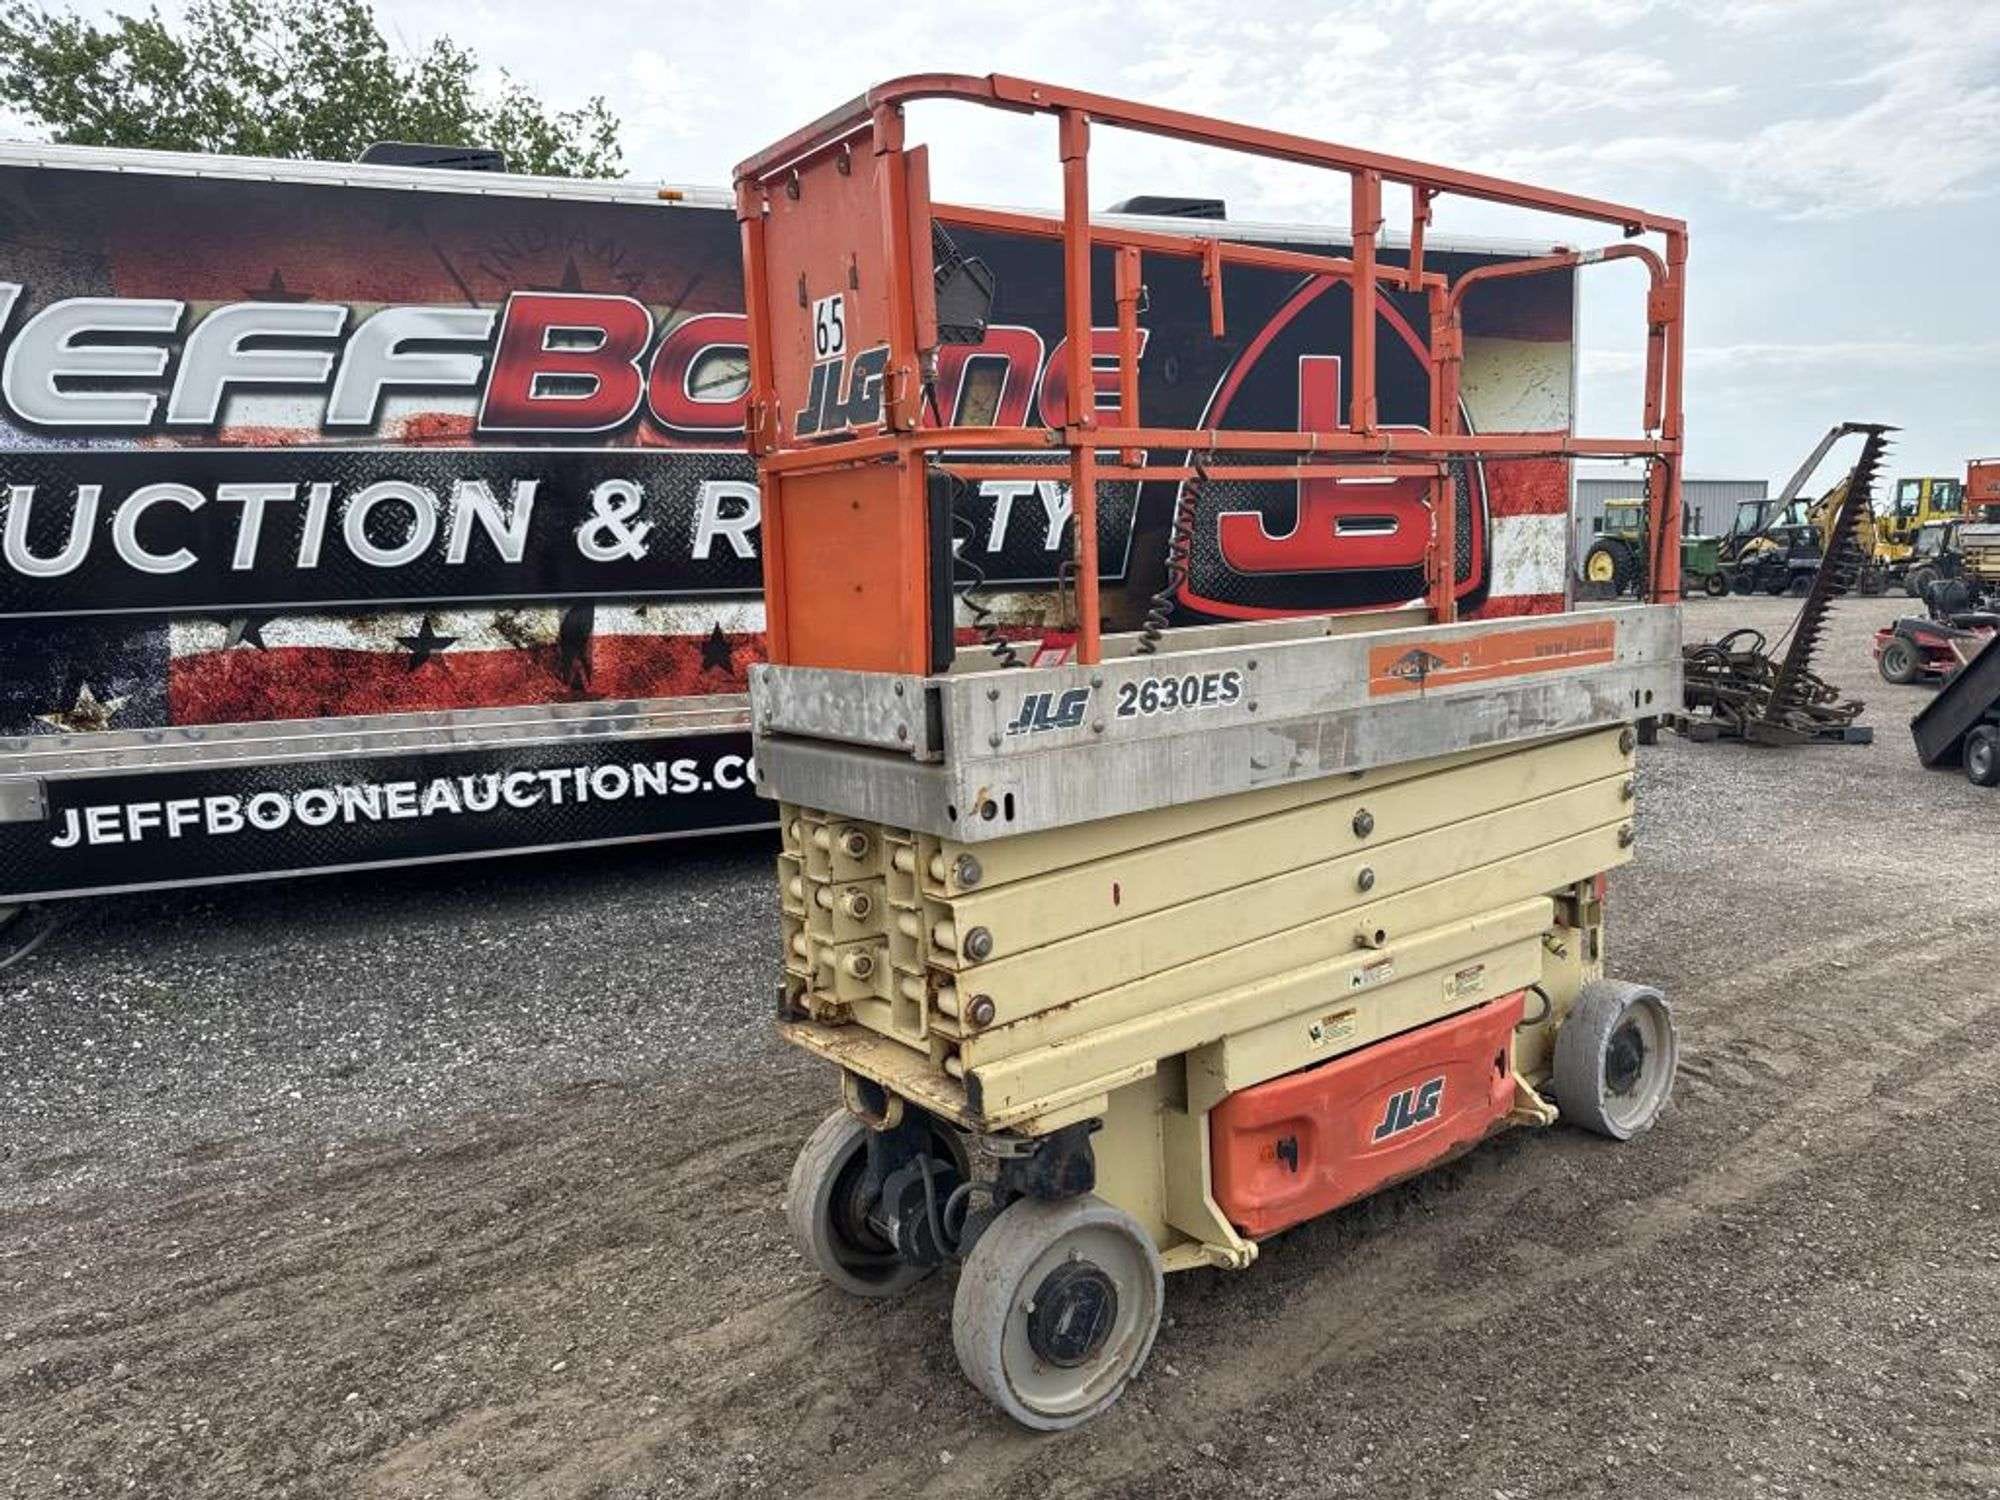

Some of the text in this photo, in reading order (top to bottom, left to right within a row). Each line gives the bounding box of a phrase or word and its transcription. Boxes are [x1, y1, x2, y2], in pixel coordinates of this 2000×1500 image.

[815, 296, 844, 356] 65
[793, 346, 892, 440] JLG
[1217, 355, 1436, 576] JB
[0, 478, 540, 577] UCTION
[576, 478, 654, 562] &
[1006, 670, 1243, 736] JLG 2630ES
[1371, 1075, 1446, 1144] JLG
